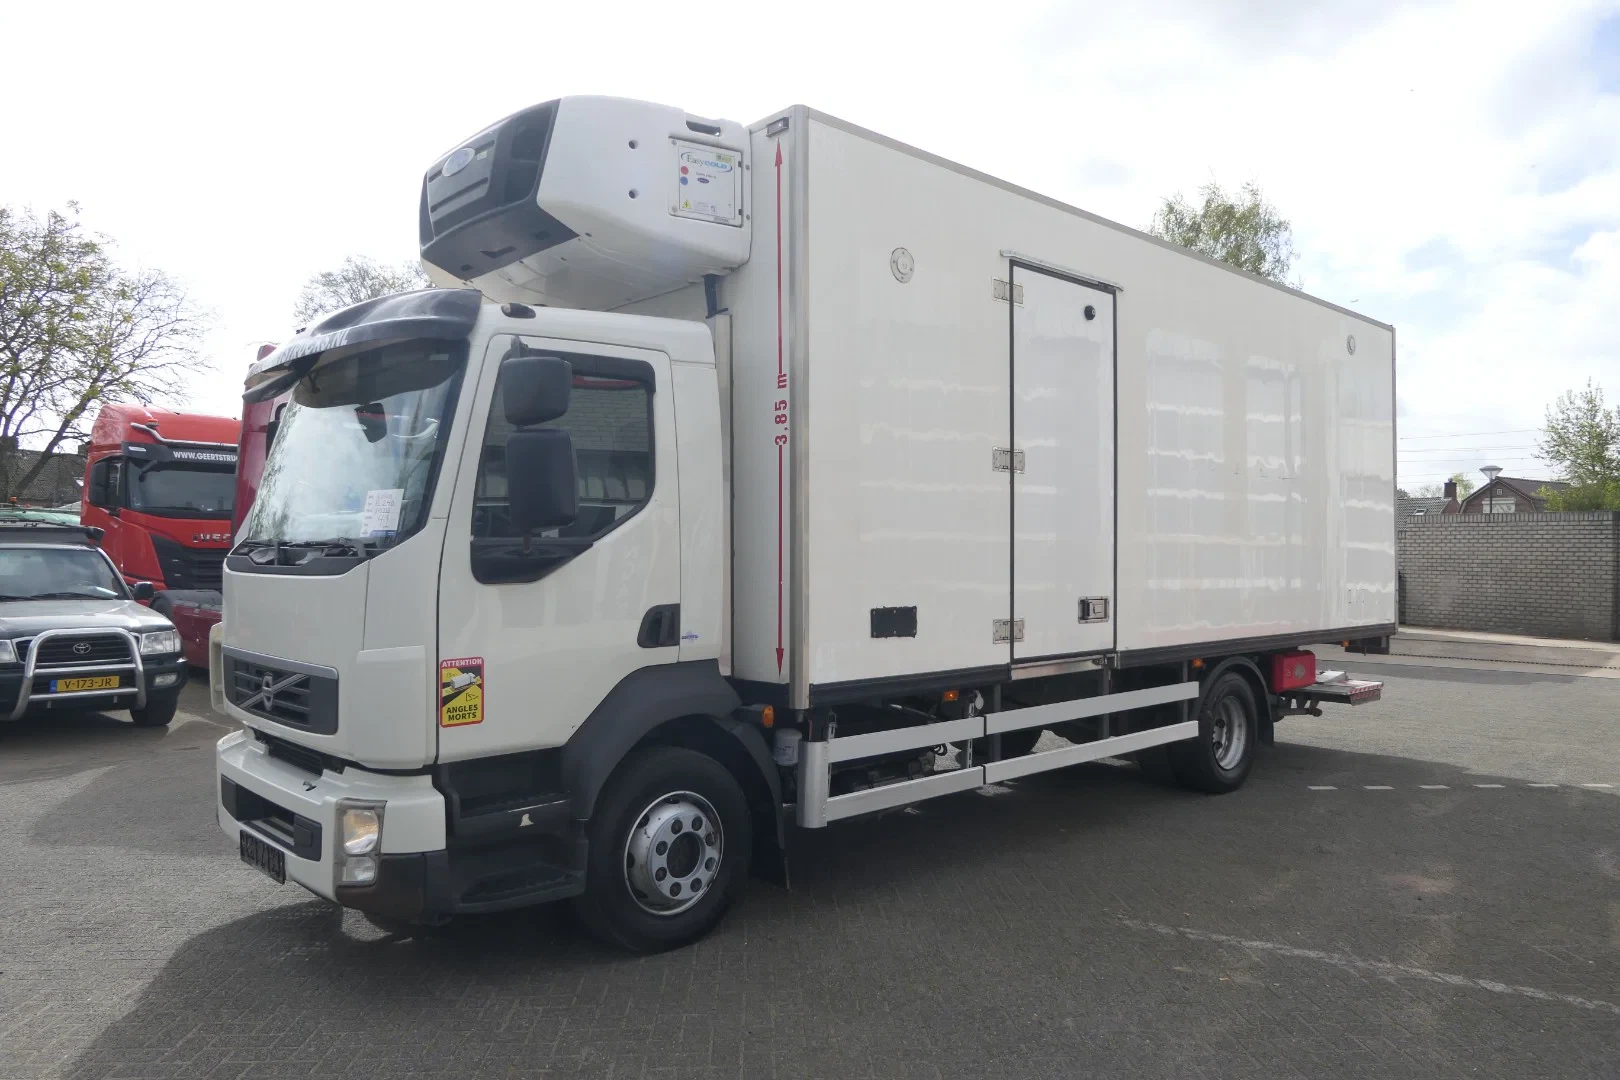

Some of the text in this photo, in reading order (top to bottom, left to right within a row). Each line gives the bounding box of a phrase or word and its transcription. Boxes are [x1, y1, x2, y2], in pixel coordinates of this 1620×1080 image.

[777, 373, 788, 389] m
[442, 658, 482, 668] ATTENTION
[64, 677, 112, 689] V-173-JR
[446, 704, 478, 714] ANGLES
[448, 711, 477, 721] MORTS
